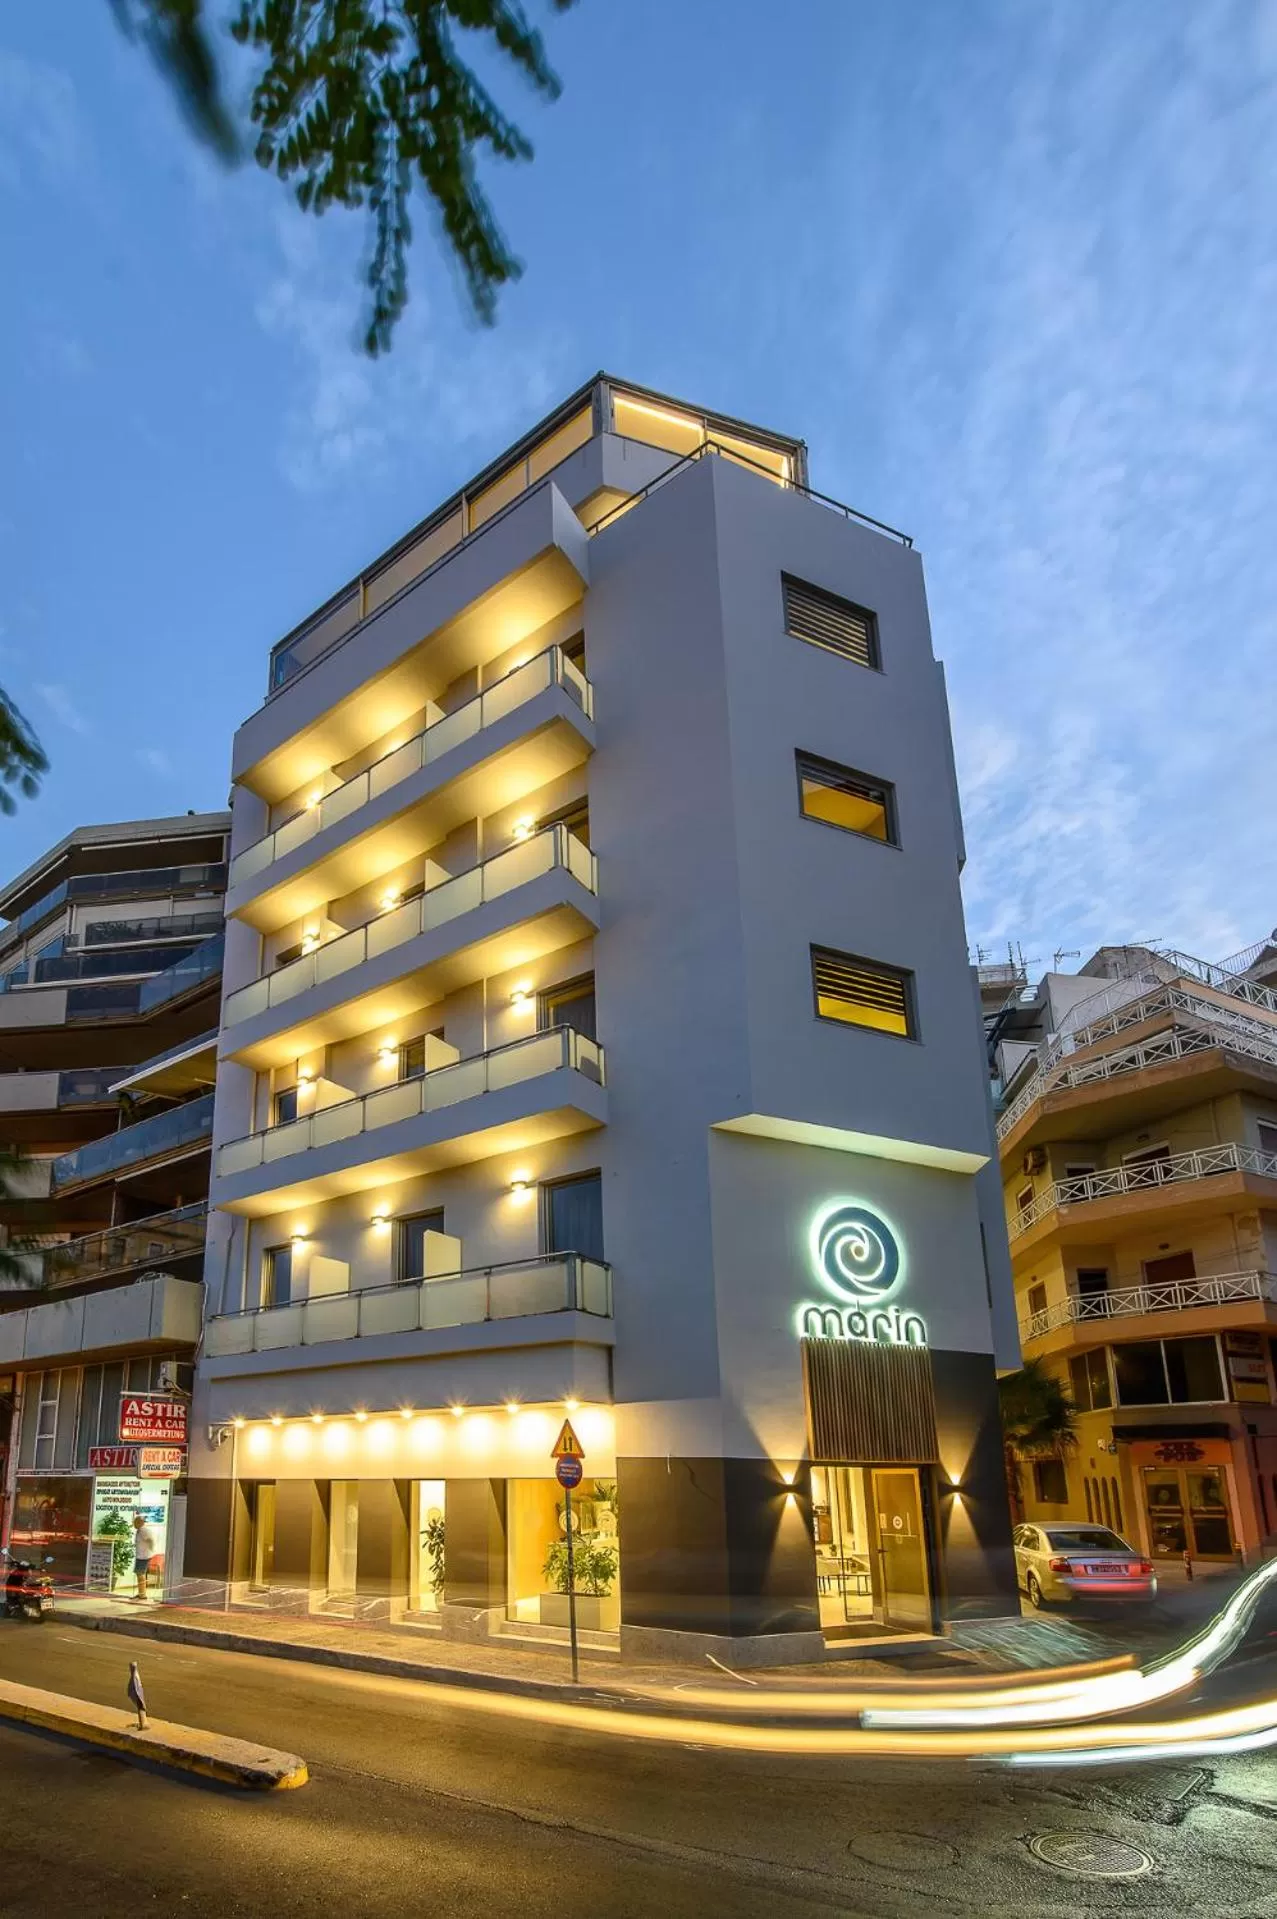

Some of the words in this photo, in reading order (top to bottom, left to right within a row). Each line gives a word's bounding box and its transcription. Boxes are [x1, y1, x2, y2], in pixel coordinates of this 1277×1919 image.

[803, 1306, 927, 1343] marin
[126, 1400, 186, 1418] ASTIR
[125, 1417, 153, 1427] RENT
[155, 1419, 163, 1428] A
[165, 1419, 185, 1429] CAR
[143, 1450, 162, 1462] RENT
